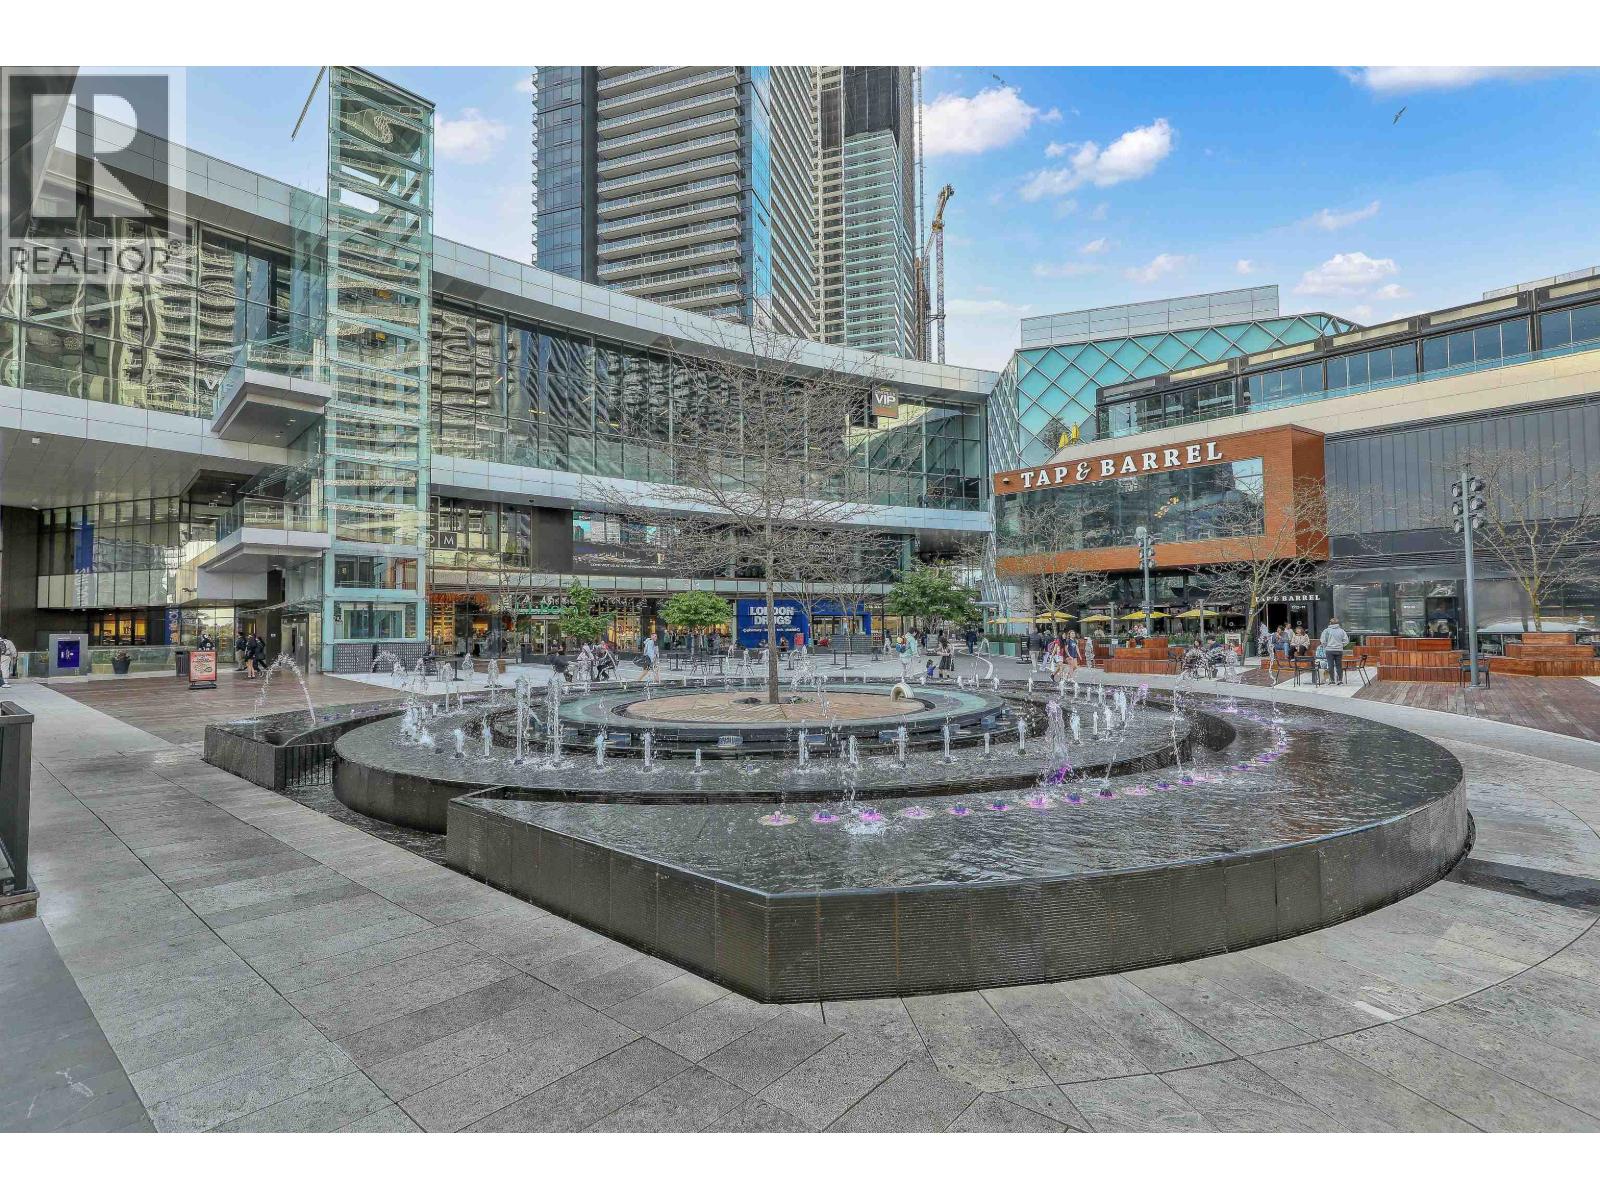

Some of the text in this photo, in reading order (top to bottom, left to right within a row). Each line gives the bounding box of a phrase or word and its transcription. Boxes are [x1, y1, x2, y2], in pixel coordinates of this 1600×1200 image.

[875, 394, 896, 406] VIP
[1021, 442, 1223, 488] TAP & BARREL
[1282, 594, 1321, 602] BARREL
[754, 616, 792, 625] DRGS
